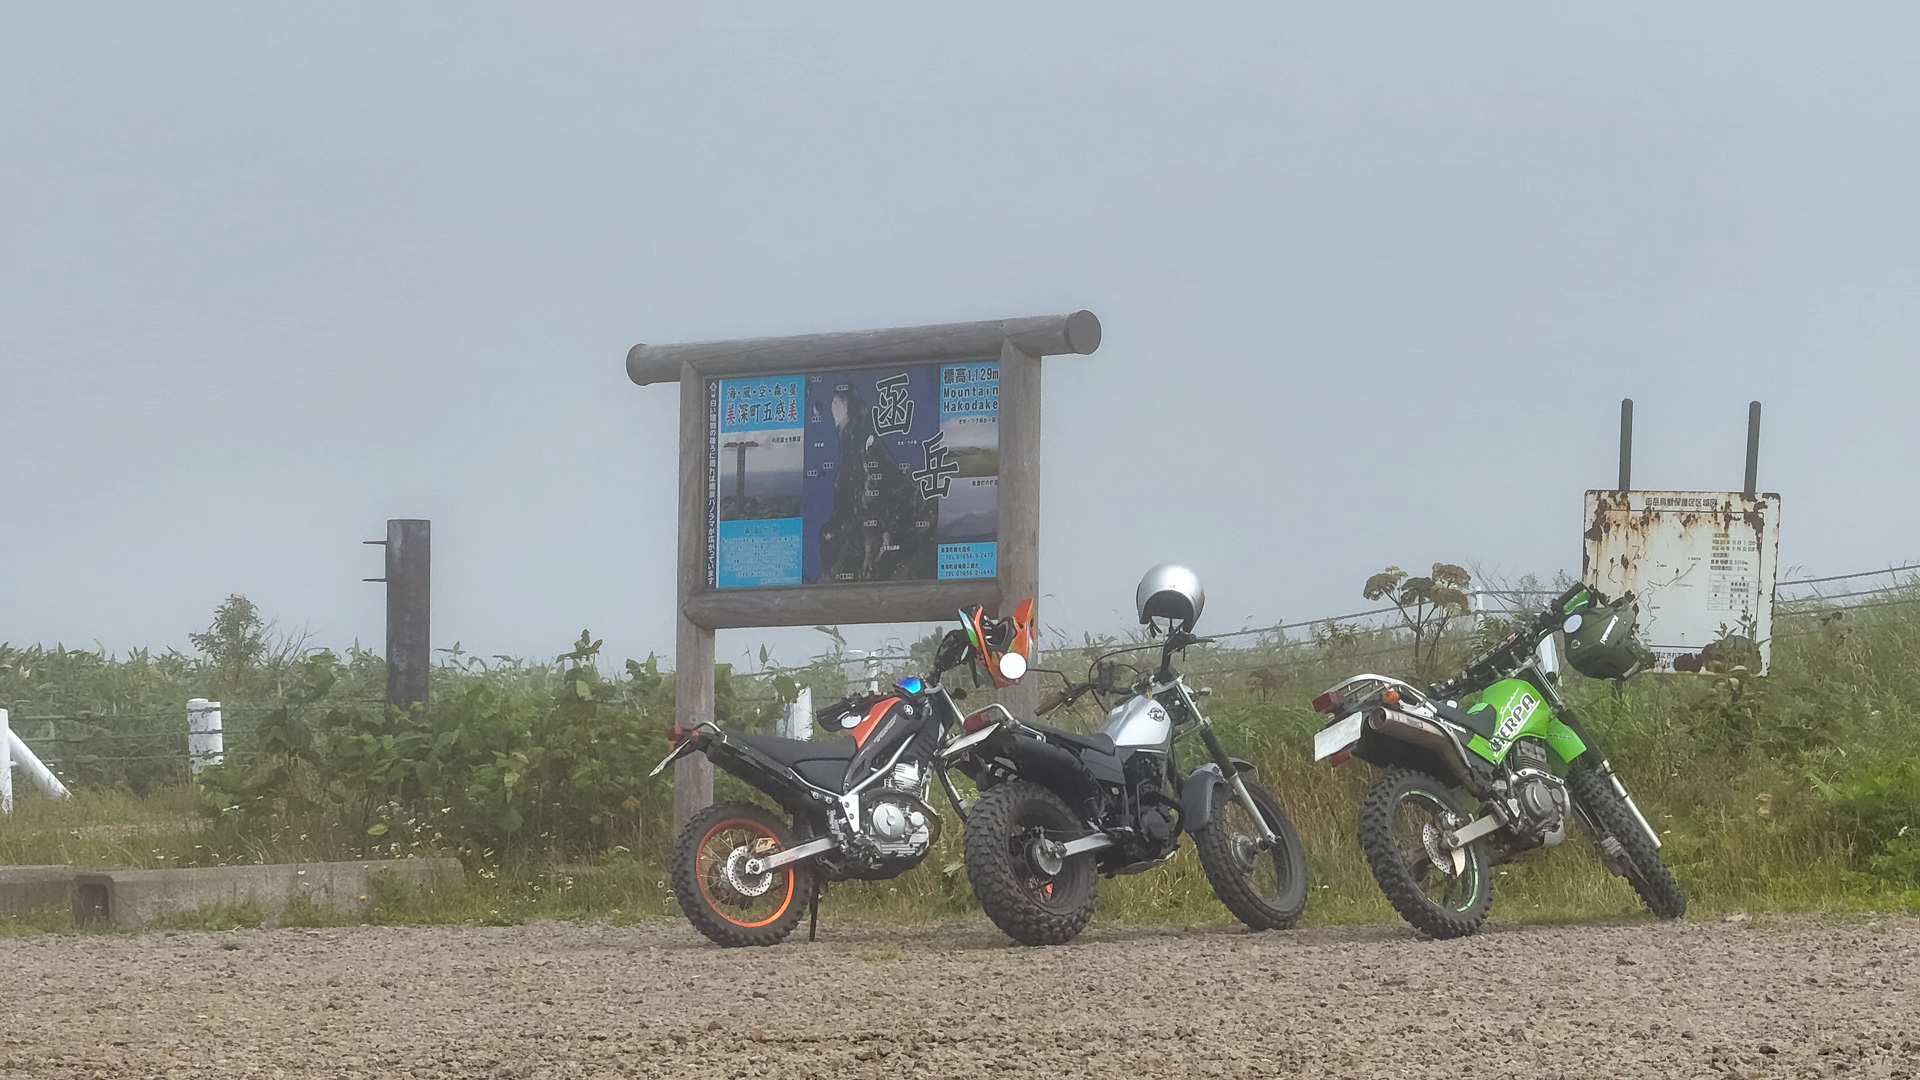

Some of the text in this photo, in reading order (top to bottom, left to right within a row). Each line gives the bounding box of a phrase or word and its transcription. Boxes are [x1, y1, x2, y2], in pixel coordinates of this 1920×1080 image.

[943, 385, 999, 398] Mountain
[726, 399, 798, 425] 美深町五感美
[943, 399, 999, 412] Hakodake
